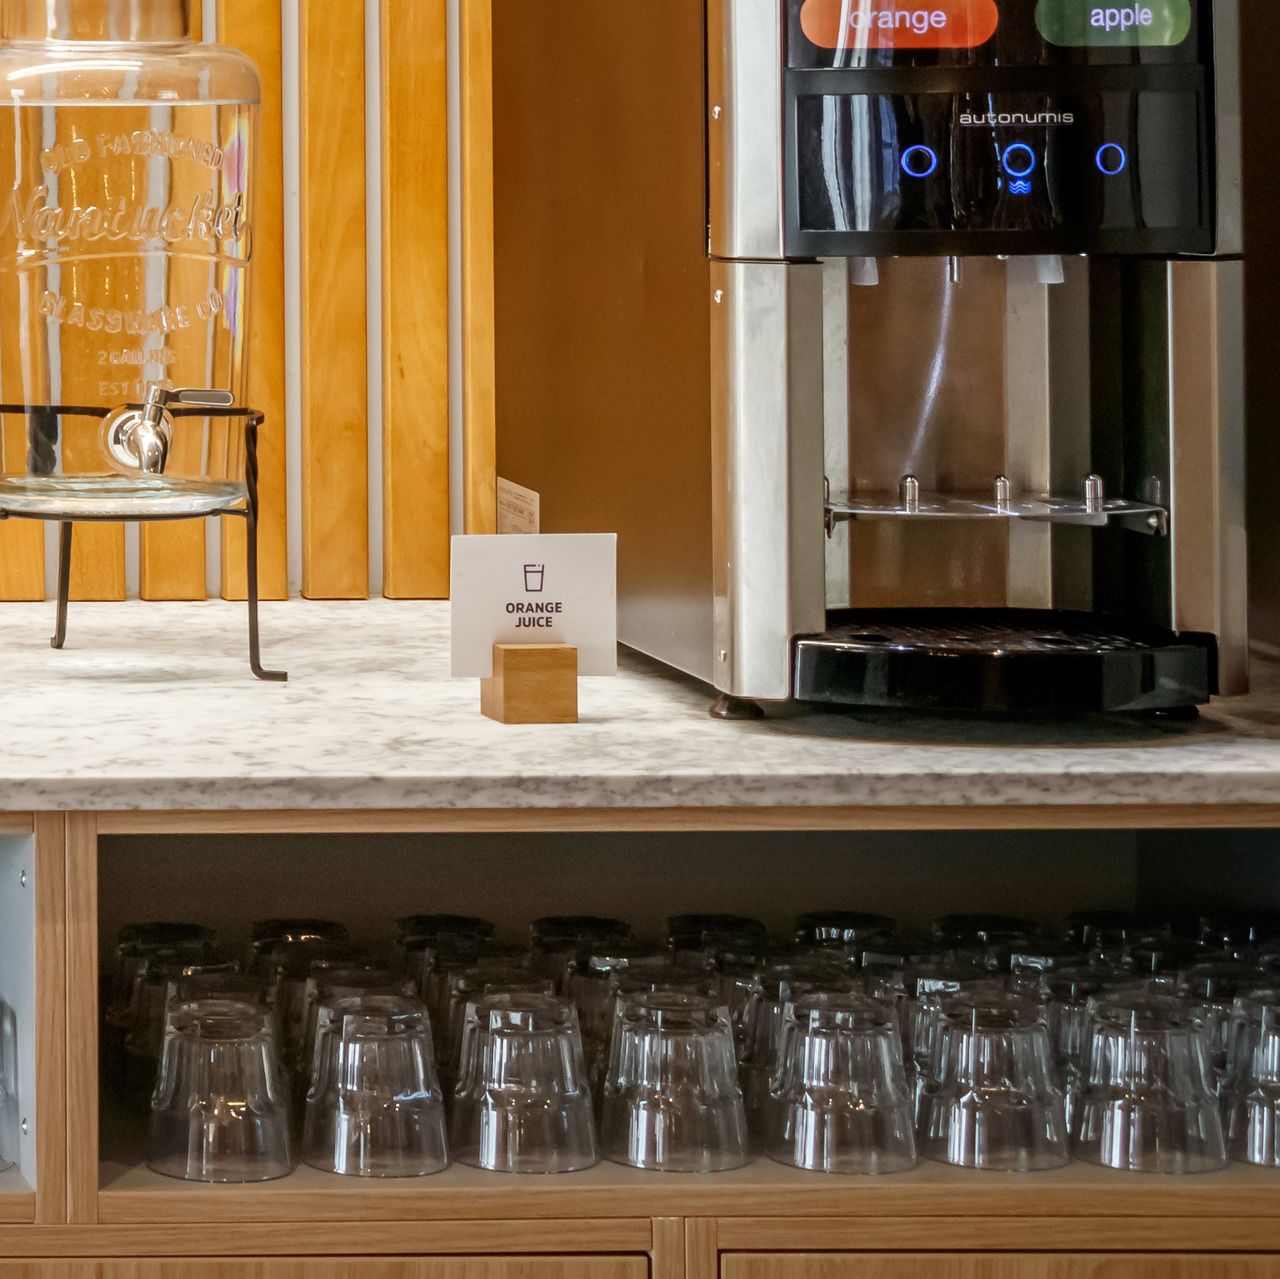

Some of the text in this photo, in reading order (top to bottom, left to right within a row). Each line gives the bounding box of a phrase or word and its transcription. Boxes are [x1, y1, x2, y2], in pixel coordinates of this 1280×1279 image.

[849, 3, 1153, 35] orange apple
[958, 109, 1075, 126] autonumis
[505, 601, 563, 615] ORANGE
[515, 616, 554, 628] JUICE
